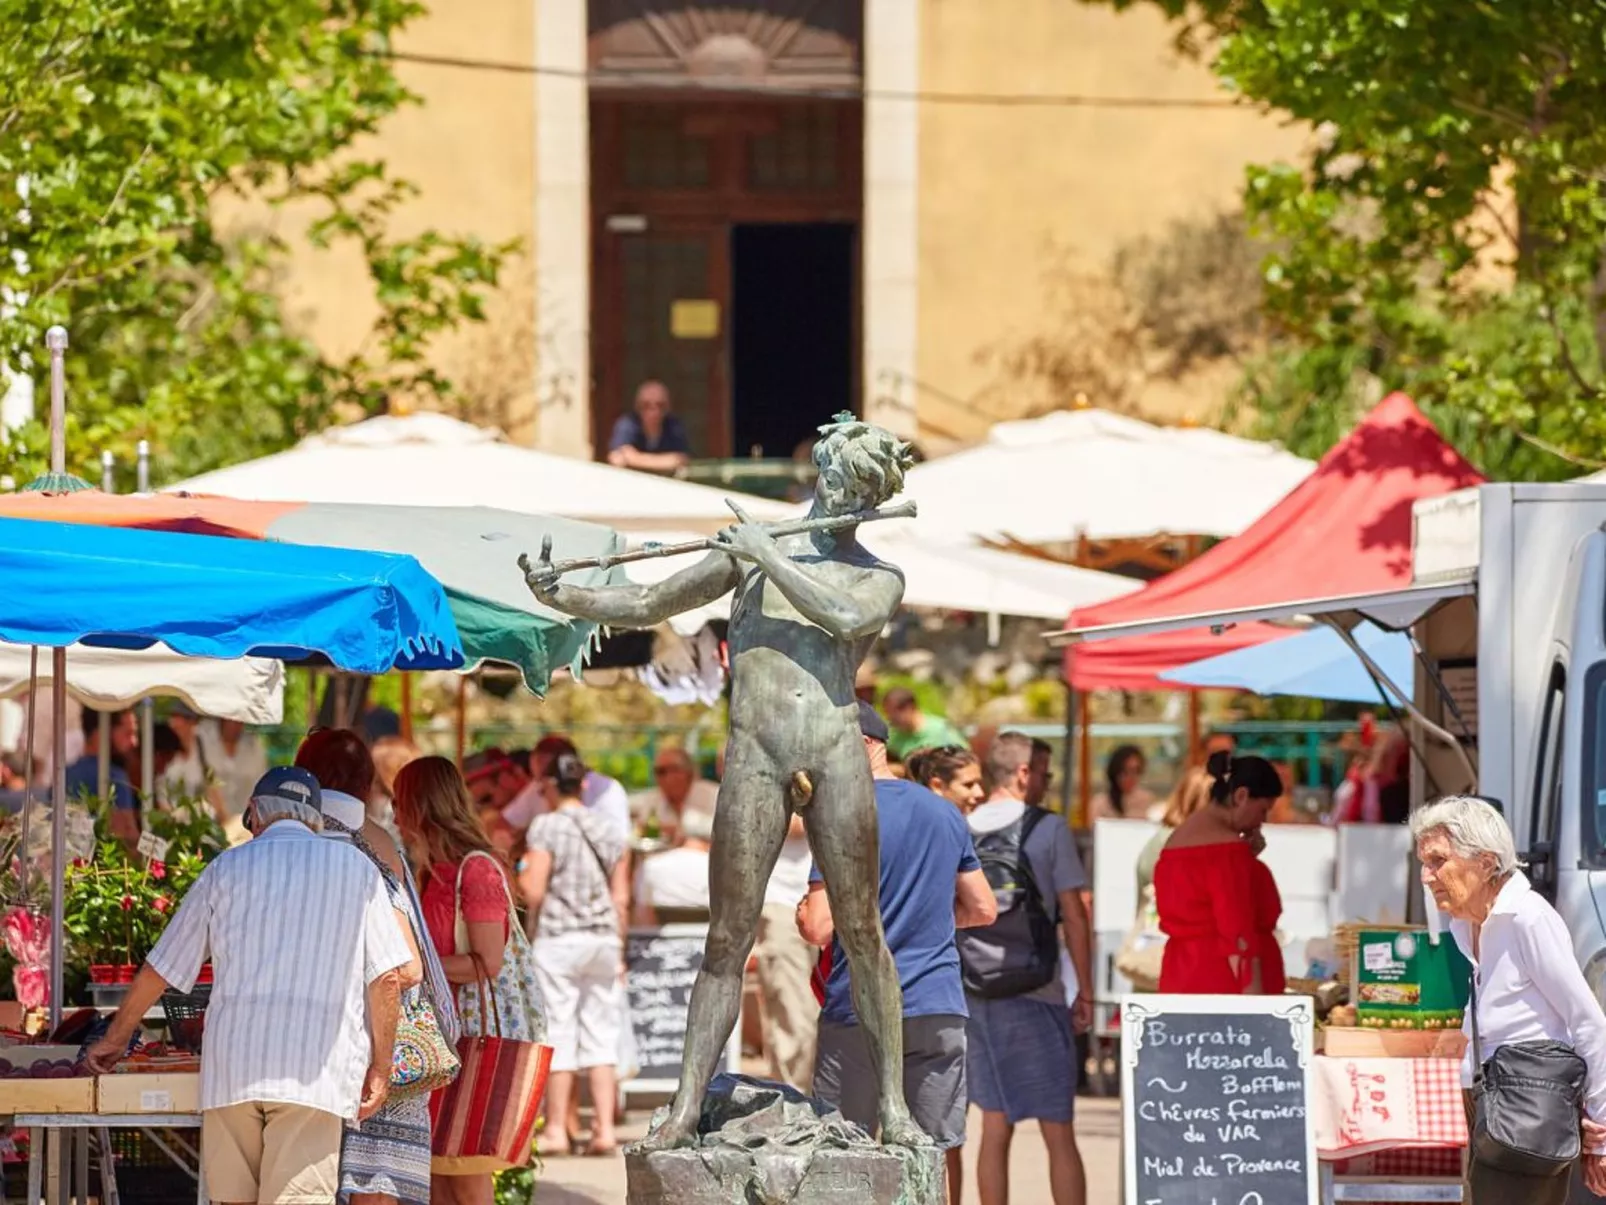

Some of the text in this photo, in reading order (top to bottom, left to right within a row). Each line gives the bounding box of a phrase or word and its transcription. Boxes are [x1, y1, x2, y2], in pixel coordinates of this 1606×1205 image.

[1183, 1124, 1261, 1143] du VAR
[1143, 1153, 1303, 1178] Miel de Provence
